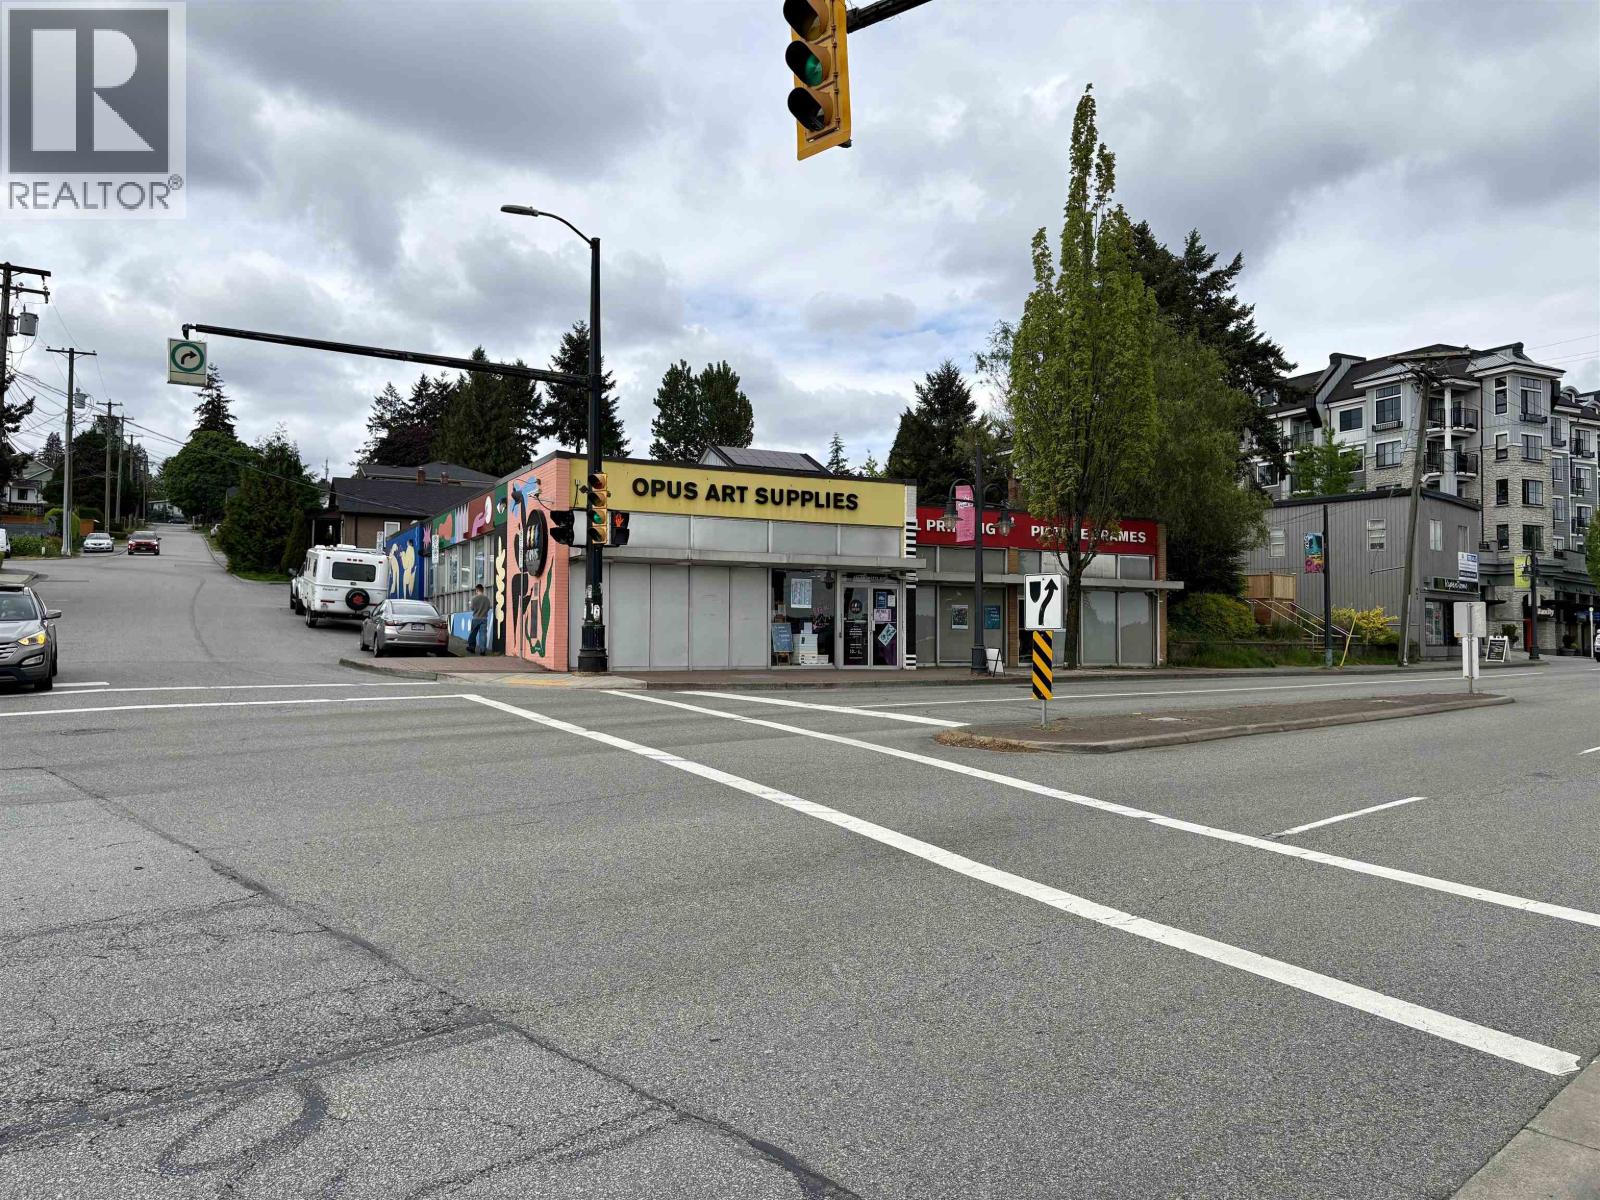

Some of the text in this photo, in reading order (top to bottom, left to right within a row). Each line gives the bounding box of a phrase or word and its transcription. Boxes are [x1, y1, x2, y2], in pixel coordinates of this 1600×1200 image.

[632, 477, 859, 511] OPUS ART SUPPLIES
[1031, 525, 1147, 544] PICTE RAMES
